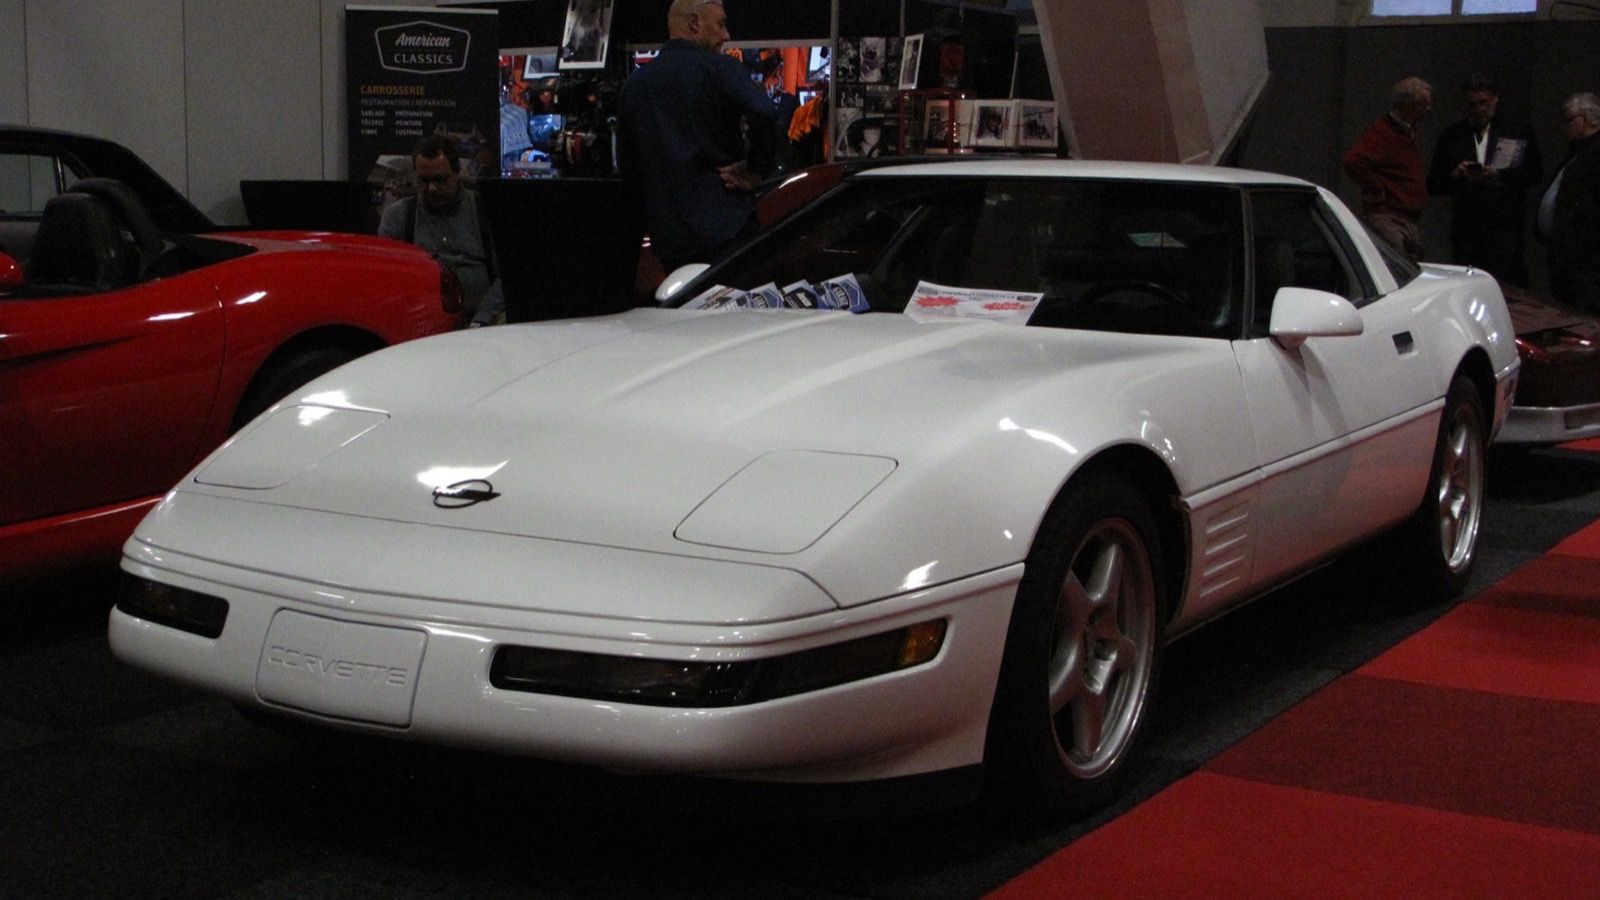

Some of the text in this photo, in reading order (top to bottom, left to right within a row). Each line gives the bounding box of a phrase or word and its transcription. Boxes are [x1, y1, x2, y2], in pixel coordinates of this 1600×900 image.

[395, 32, 451, 48] American
[394, 53, 453, 65] CLASSICS
[360, 85, 426, 96] CARROSSERIE
[360, 98, 410, 107] RESTAURATION
[267, 645, 408, 686] CORVETTE
